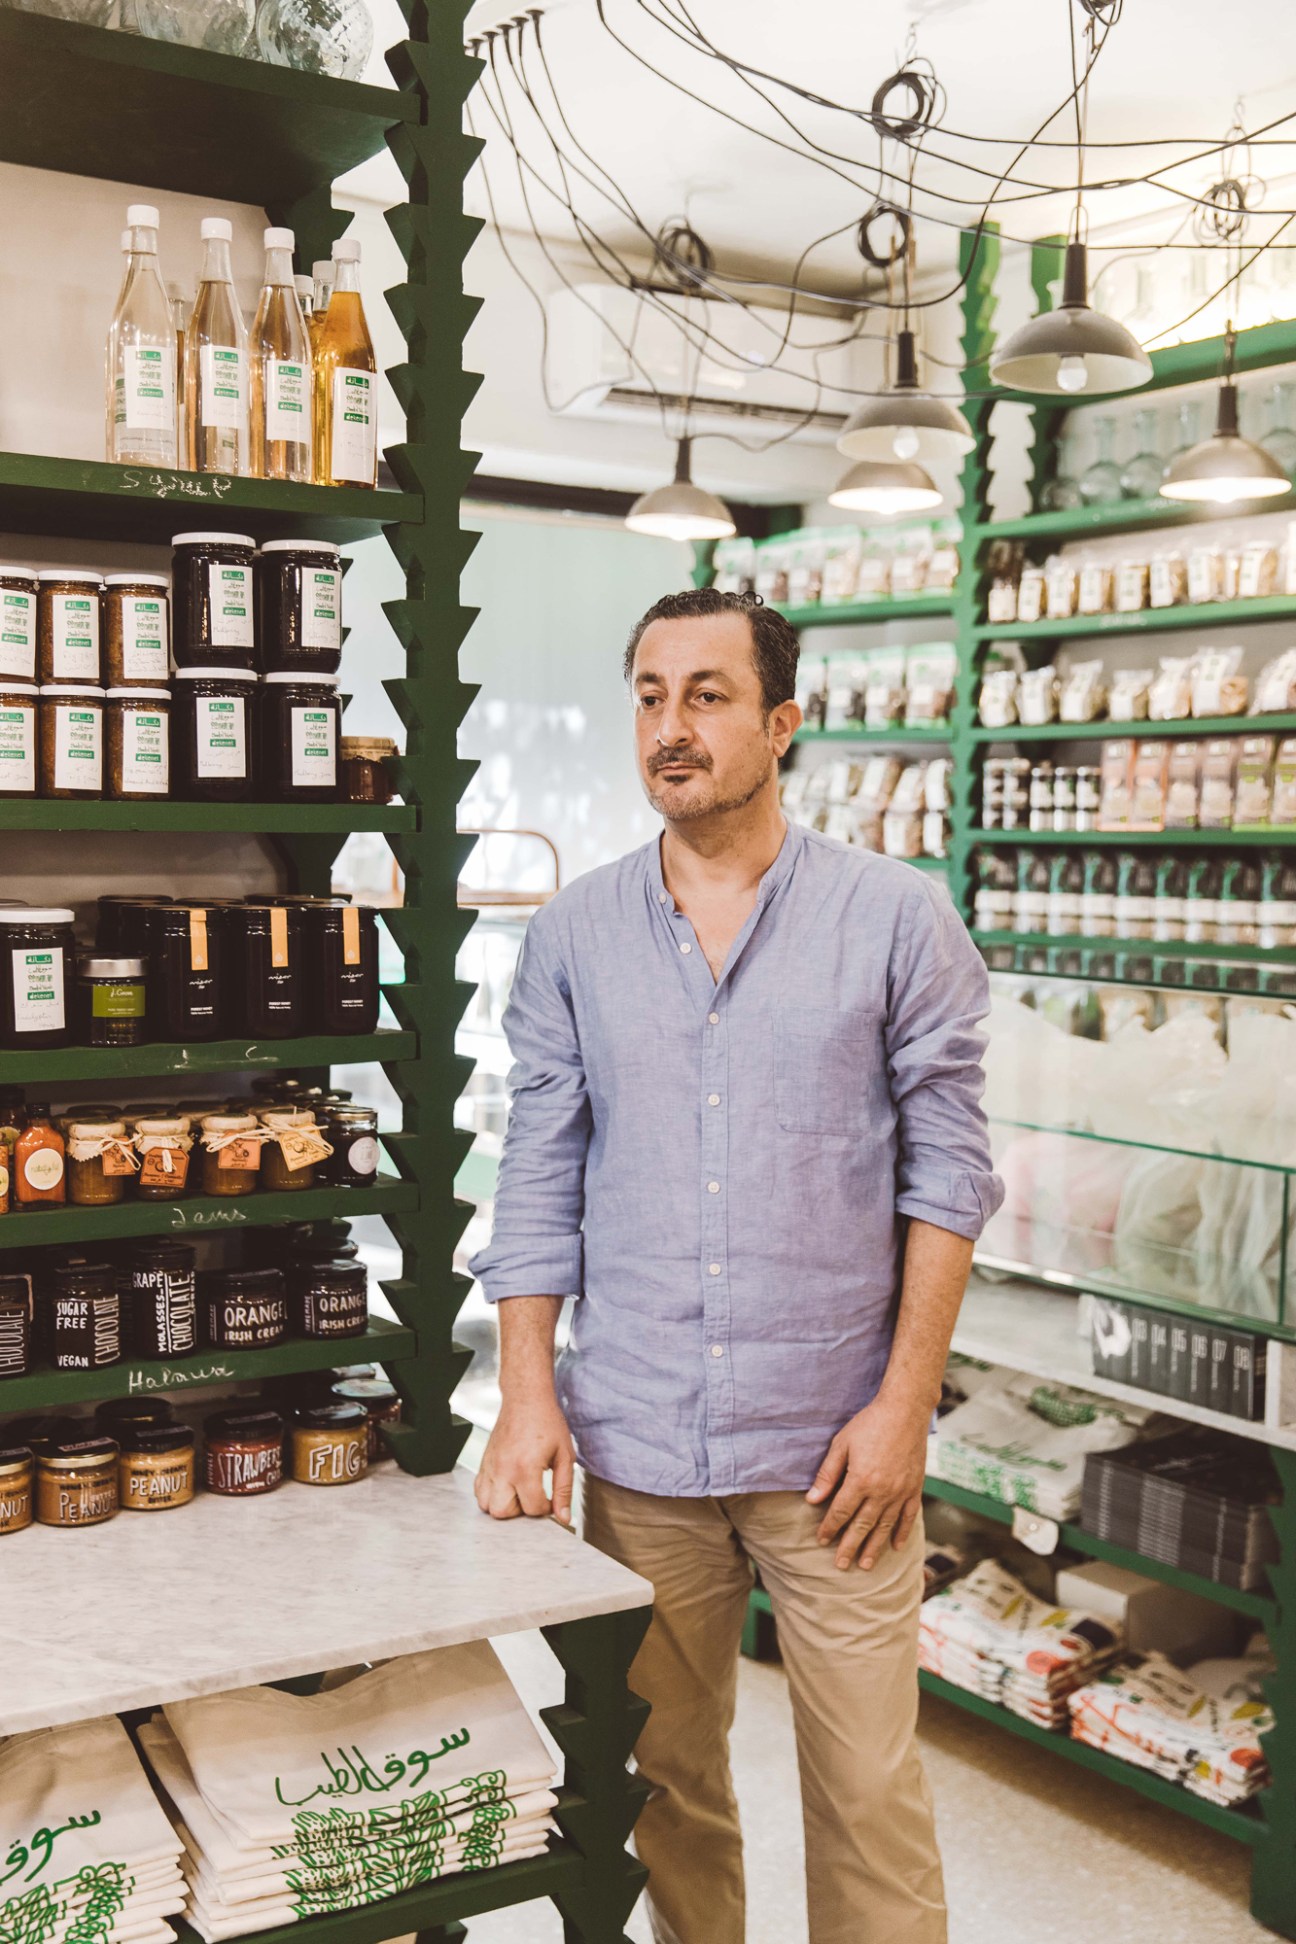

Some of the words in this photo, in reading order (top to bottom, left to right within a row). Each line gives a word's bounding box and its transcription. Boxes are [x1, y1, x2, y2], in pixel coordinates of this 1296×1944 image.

[133, 1271, 164, 1288] GRAPE
[56, 1302, 89, 1316] SUGAR
[169, 1274, 194, 1351] CHOCOLATE
[224, 1300, 284, 1328] ORANGE
[56, 1317, 88, 1331] FREE
[93, 1293, 121, 1365] CHOCOLATE
[224, 1329, 253, 1342] IRISH
[57, 1355, 89, 1367] VEGAN
[129, 1472, 188, 1496] PEANUT
[0, 1494, 29, 1518] NUT
